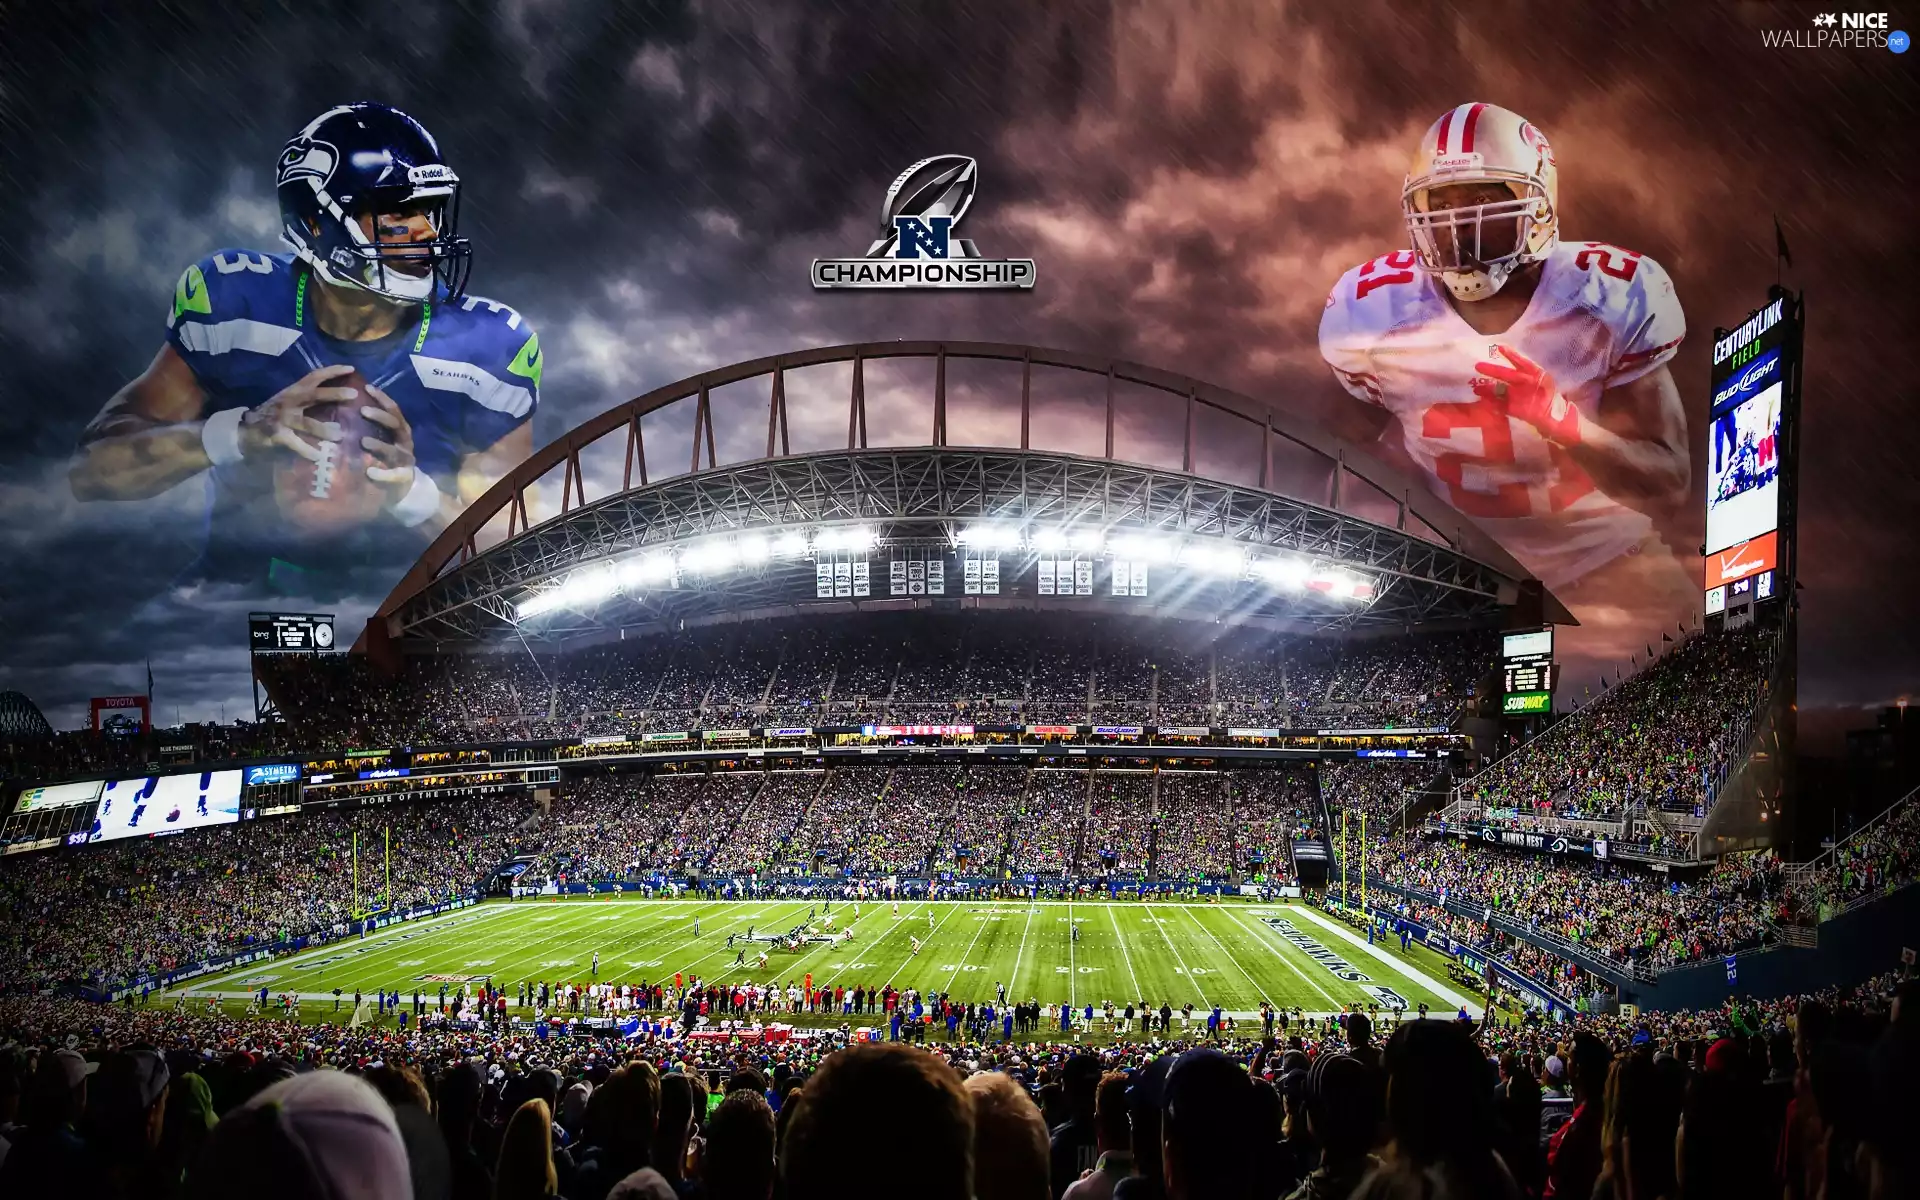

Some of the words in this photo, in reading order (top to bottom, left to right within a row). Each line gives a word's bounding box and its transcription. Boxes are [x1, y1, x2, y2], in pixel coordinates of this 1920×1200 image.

[1714, 297, 1783, 366] CENTURYLINK
[1732, 339, 1760, 370] FIELD
[1714, 383, 1740, 406] BUD
[1741, 356, 1778, 389] LIGHT
[253, 631, 270, 640] bing
[105, 698, 135, 707] TOYOTA
[1504, 694, 1549, 711] SUBWAY
[264, 765, 297, 776] SYMETRA
[361, 796, 392, 805] HOME
[419, 791, 439, 799] THE
[447, 788, 473, 796] 12TH
[480, 786, 504, 794] MAN
[1501, 831, 1525, 846] HAWKS
[1526, 834, 1544, 848] NEST
[1256, 917, 1375, 982] SEAHAWKS
